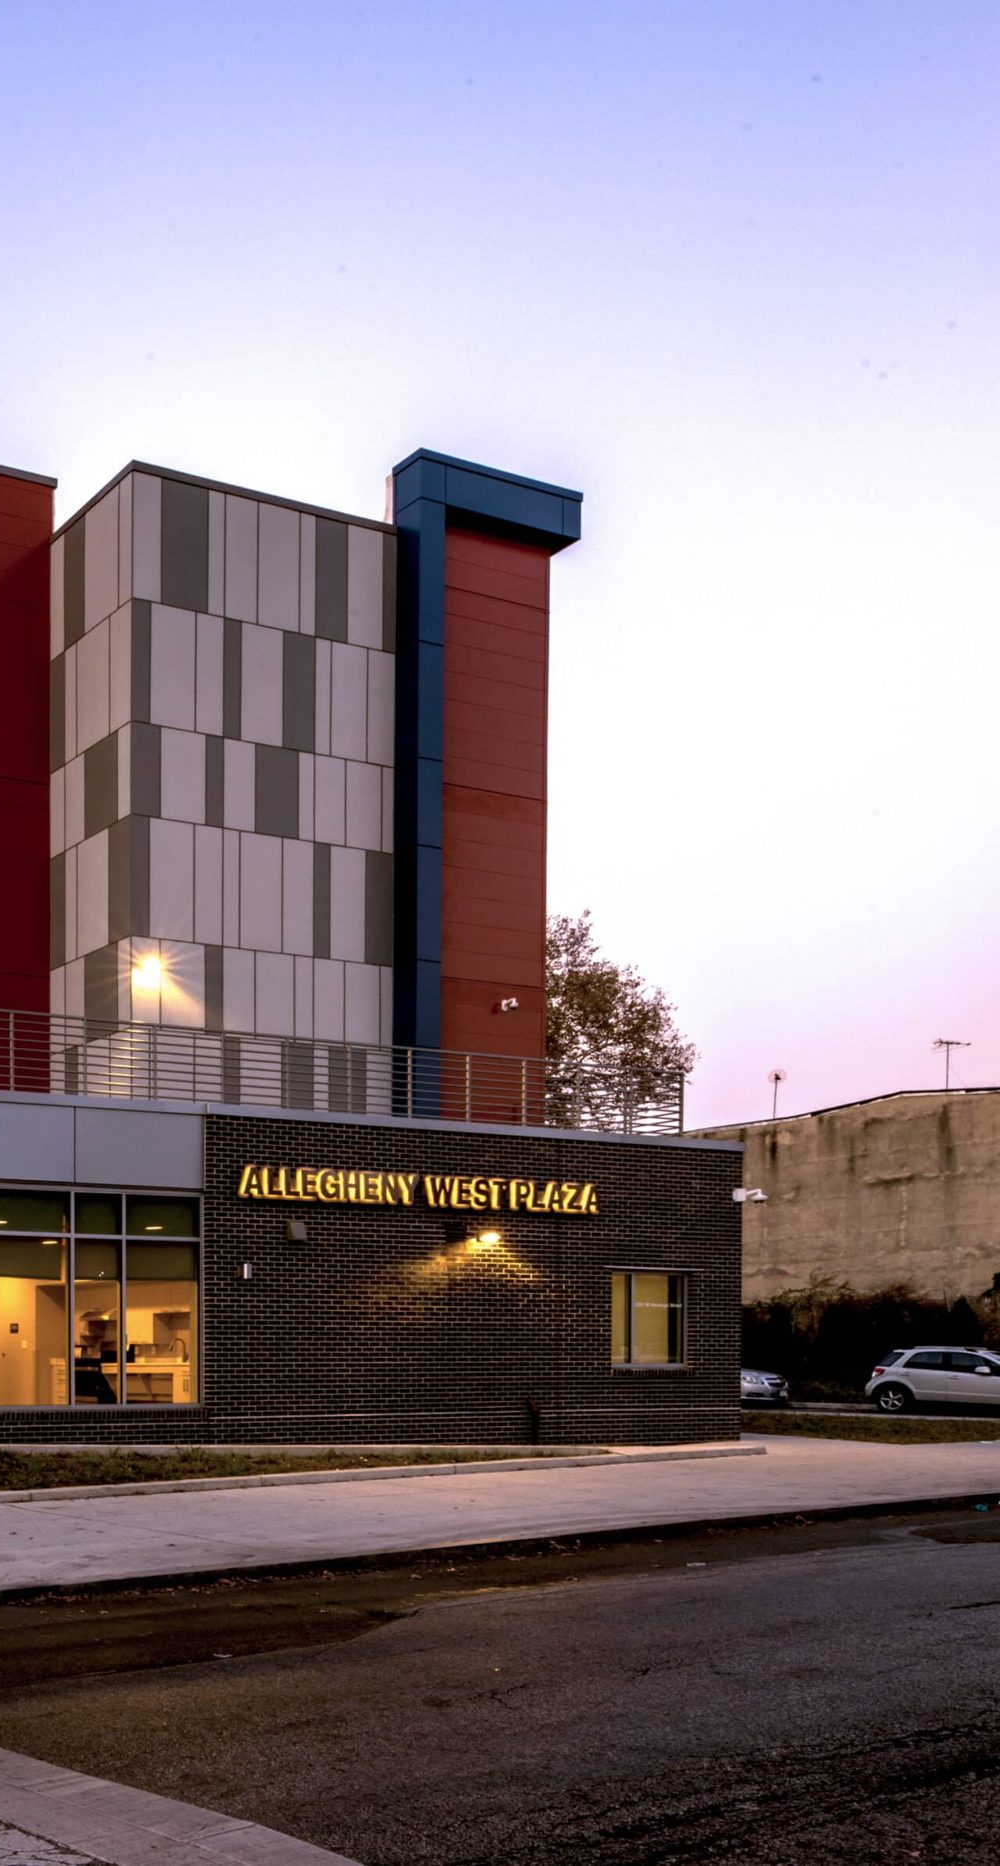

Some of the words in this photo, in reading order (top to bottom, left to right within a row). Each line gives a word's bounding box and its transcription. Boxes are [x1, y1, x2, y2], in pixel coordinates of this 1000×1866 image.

[238, 1164, 419, 1206] ALLEGHENY
[424, 1174, 507, 1211] WEST
[509, 1179, 600, 1215] PLAZA
